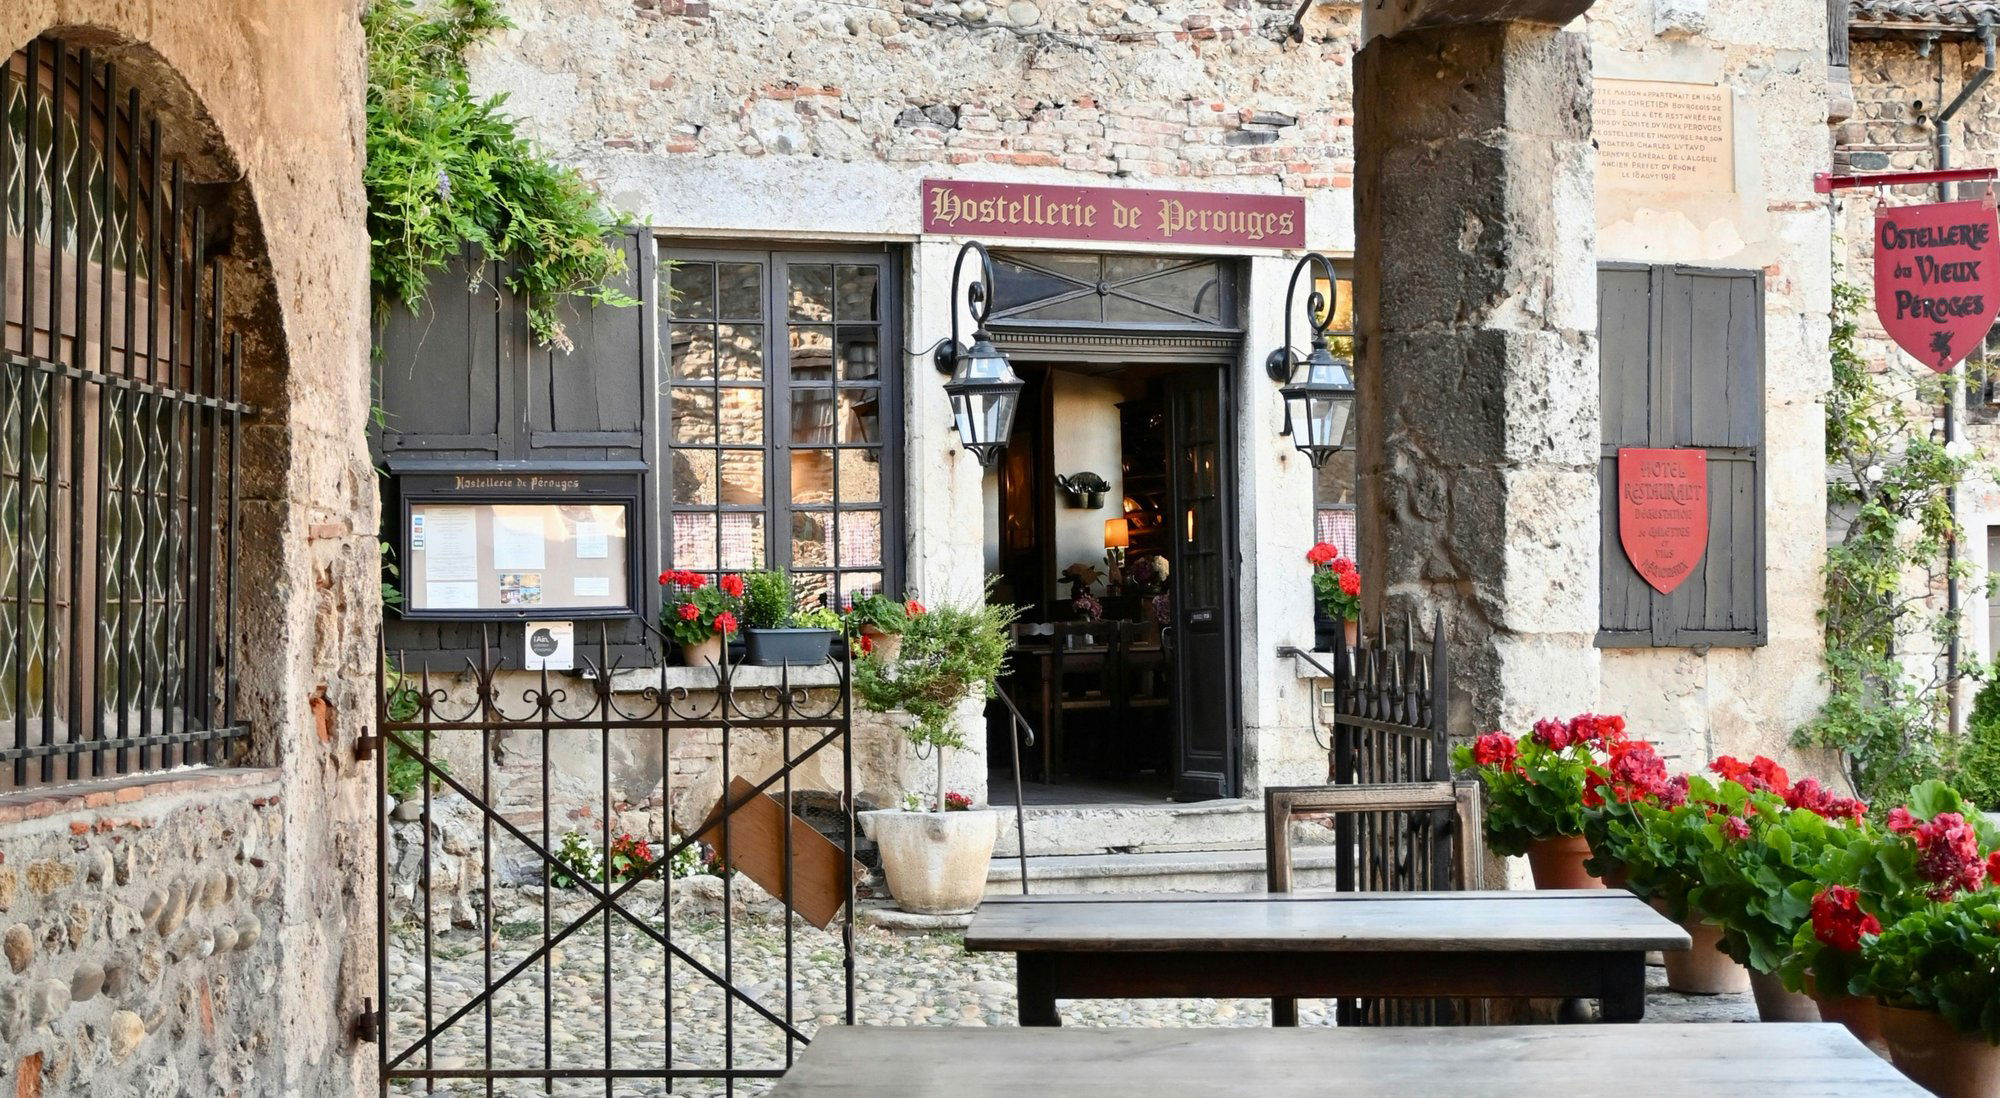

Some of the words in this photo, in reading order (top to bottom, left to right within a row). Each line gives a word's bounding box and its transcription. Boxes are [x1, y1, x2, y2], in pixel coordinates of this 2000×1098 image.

[931, 187, 1096, 227] Hostellerie
[1112, 200, 1142, 230] de
[1157, 198, 1295, 240] Perouges
[455, 476, 512, 490] Hostellerie
[517, 478, 527, 487] de
[530, 477, 580, 491] Pérouges
